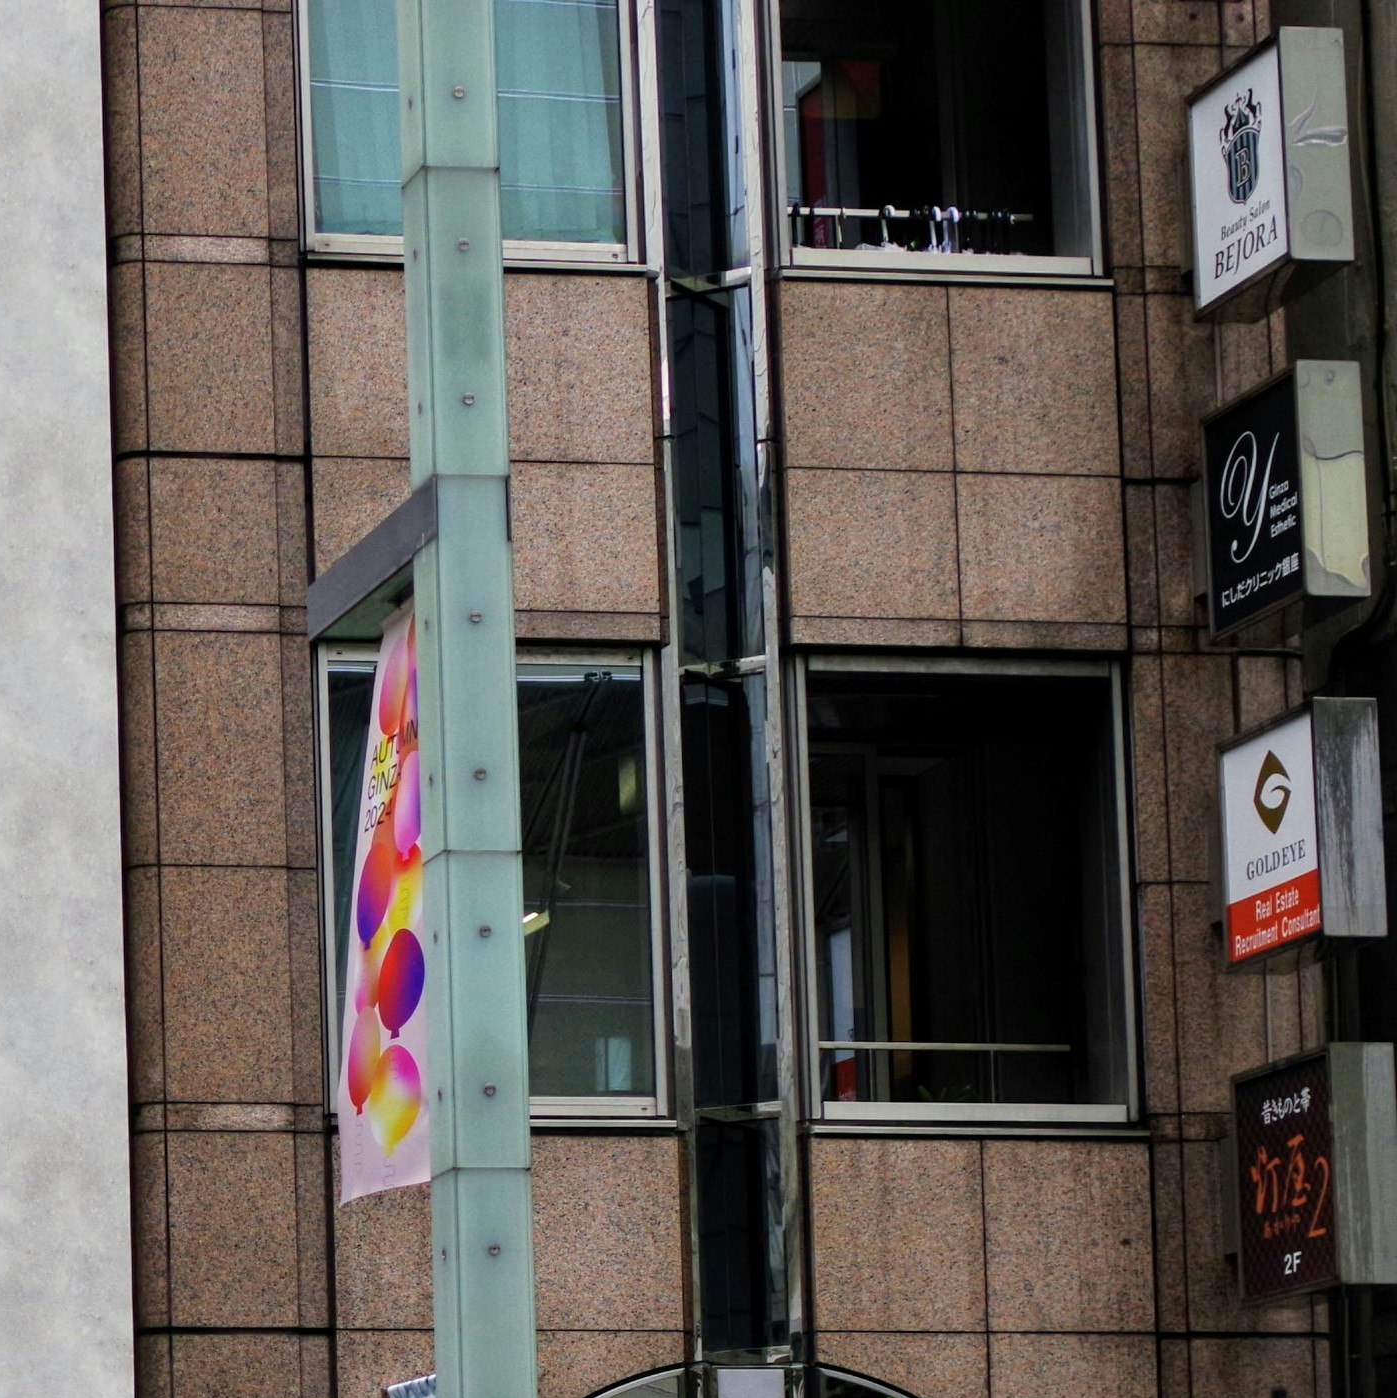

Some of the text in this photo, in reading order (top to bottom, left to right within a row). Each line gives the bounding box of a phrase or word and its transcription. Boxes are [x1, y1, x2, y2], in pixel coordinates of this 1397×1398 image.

[1221, 200, 1270, 241] Beauty Salon
[1214, 214, 1278, 280] BEJORA
[1269, 480, 1289, 500] Ginza
[1269, 492, 1298, 519] Medical
[1270, 514, 1297, 538] Esthetic
[1222, 552, 1300, 608] にしだクリニック銀座
[364, 798, 392, 833] 2024
[1246, 839, 1306, 881] GOLDEYE
[1255, 887, 1299, 921] Real Estate
[1235, 904, 1320, 956] Recruitment Consultant
[1284, 1251, 1302, 1275] 2F
